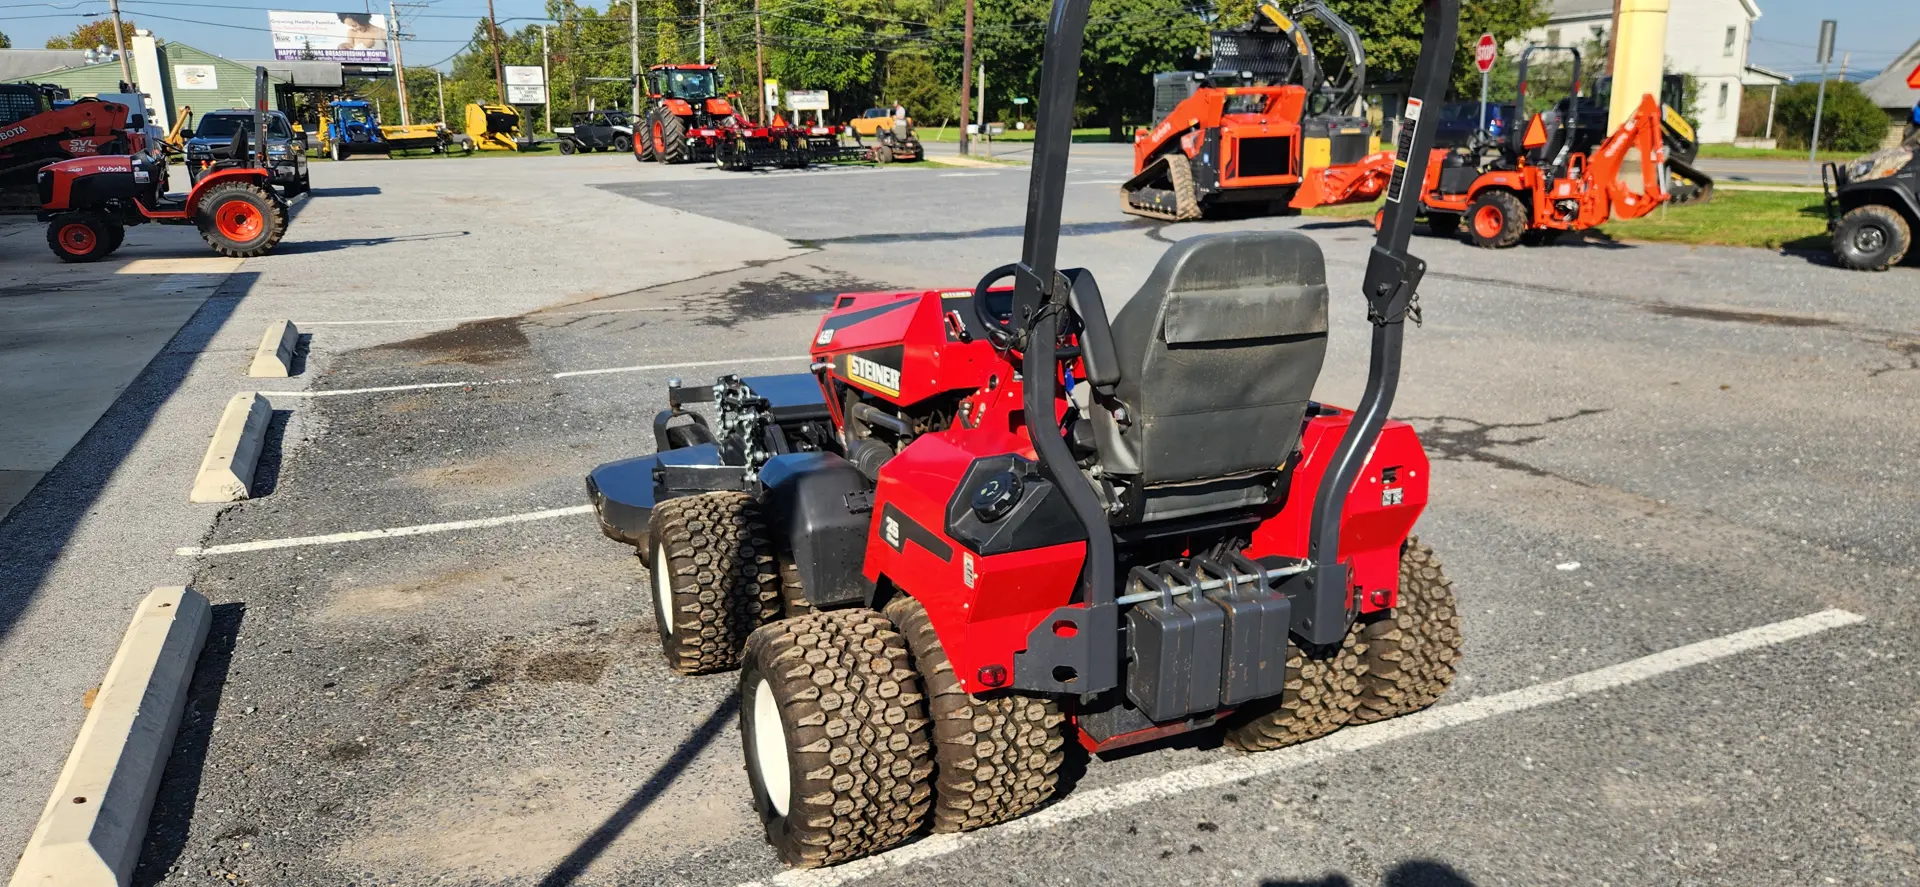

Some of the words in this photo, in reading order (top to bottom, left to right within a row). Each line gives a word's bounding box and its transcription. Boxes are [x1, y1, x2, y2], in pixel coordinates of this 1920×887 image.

[325, 50, 366, 58] BREASTFEEDING
[1477, 44, 1496, 60] STOP
[69, 139, 97, 147] SVL
[851, 355, 900, 391] STEINER
[885, 515, 900, 539] 25
